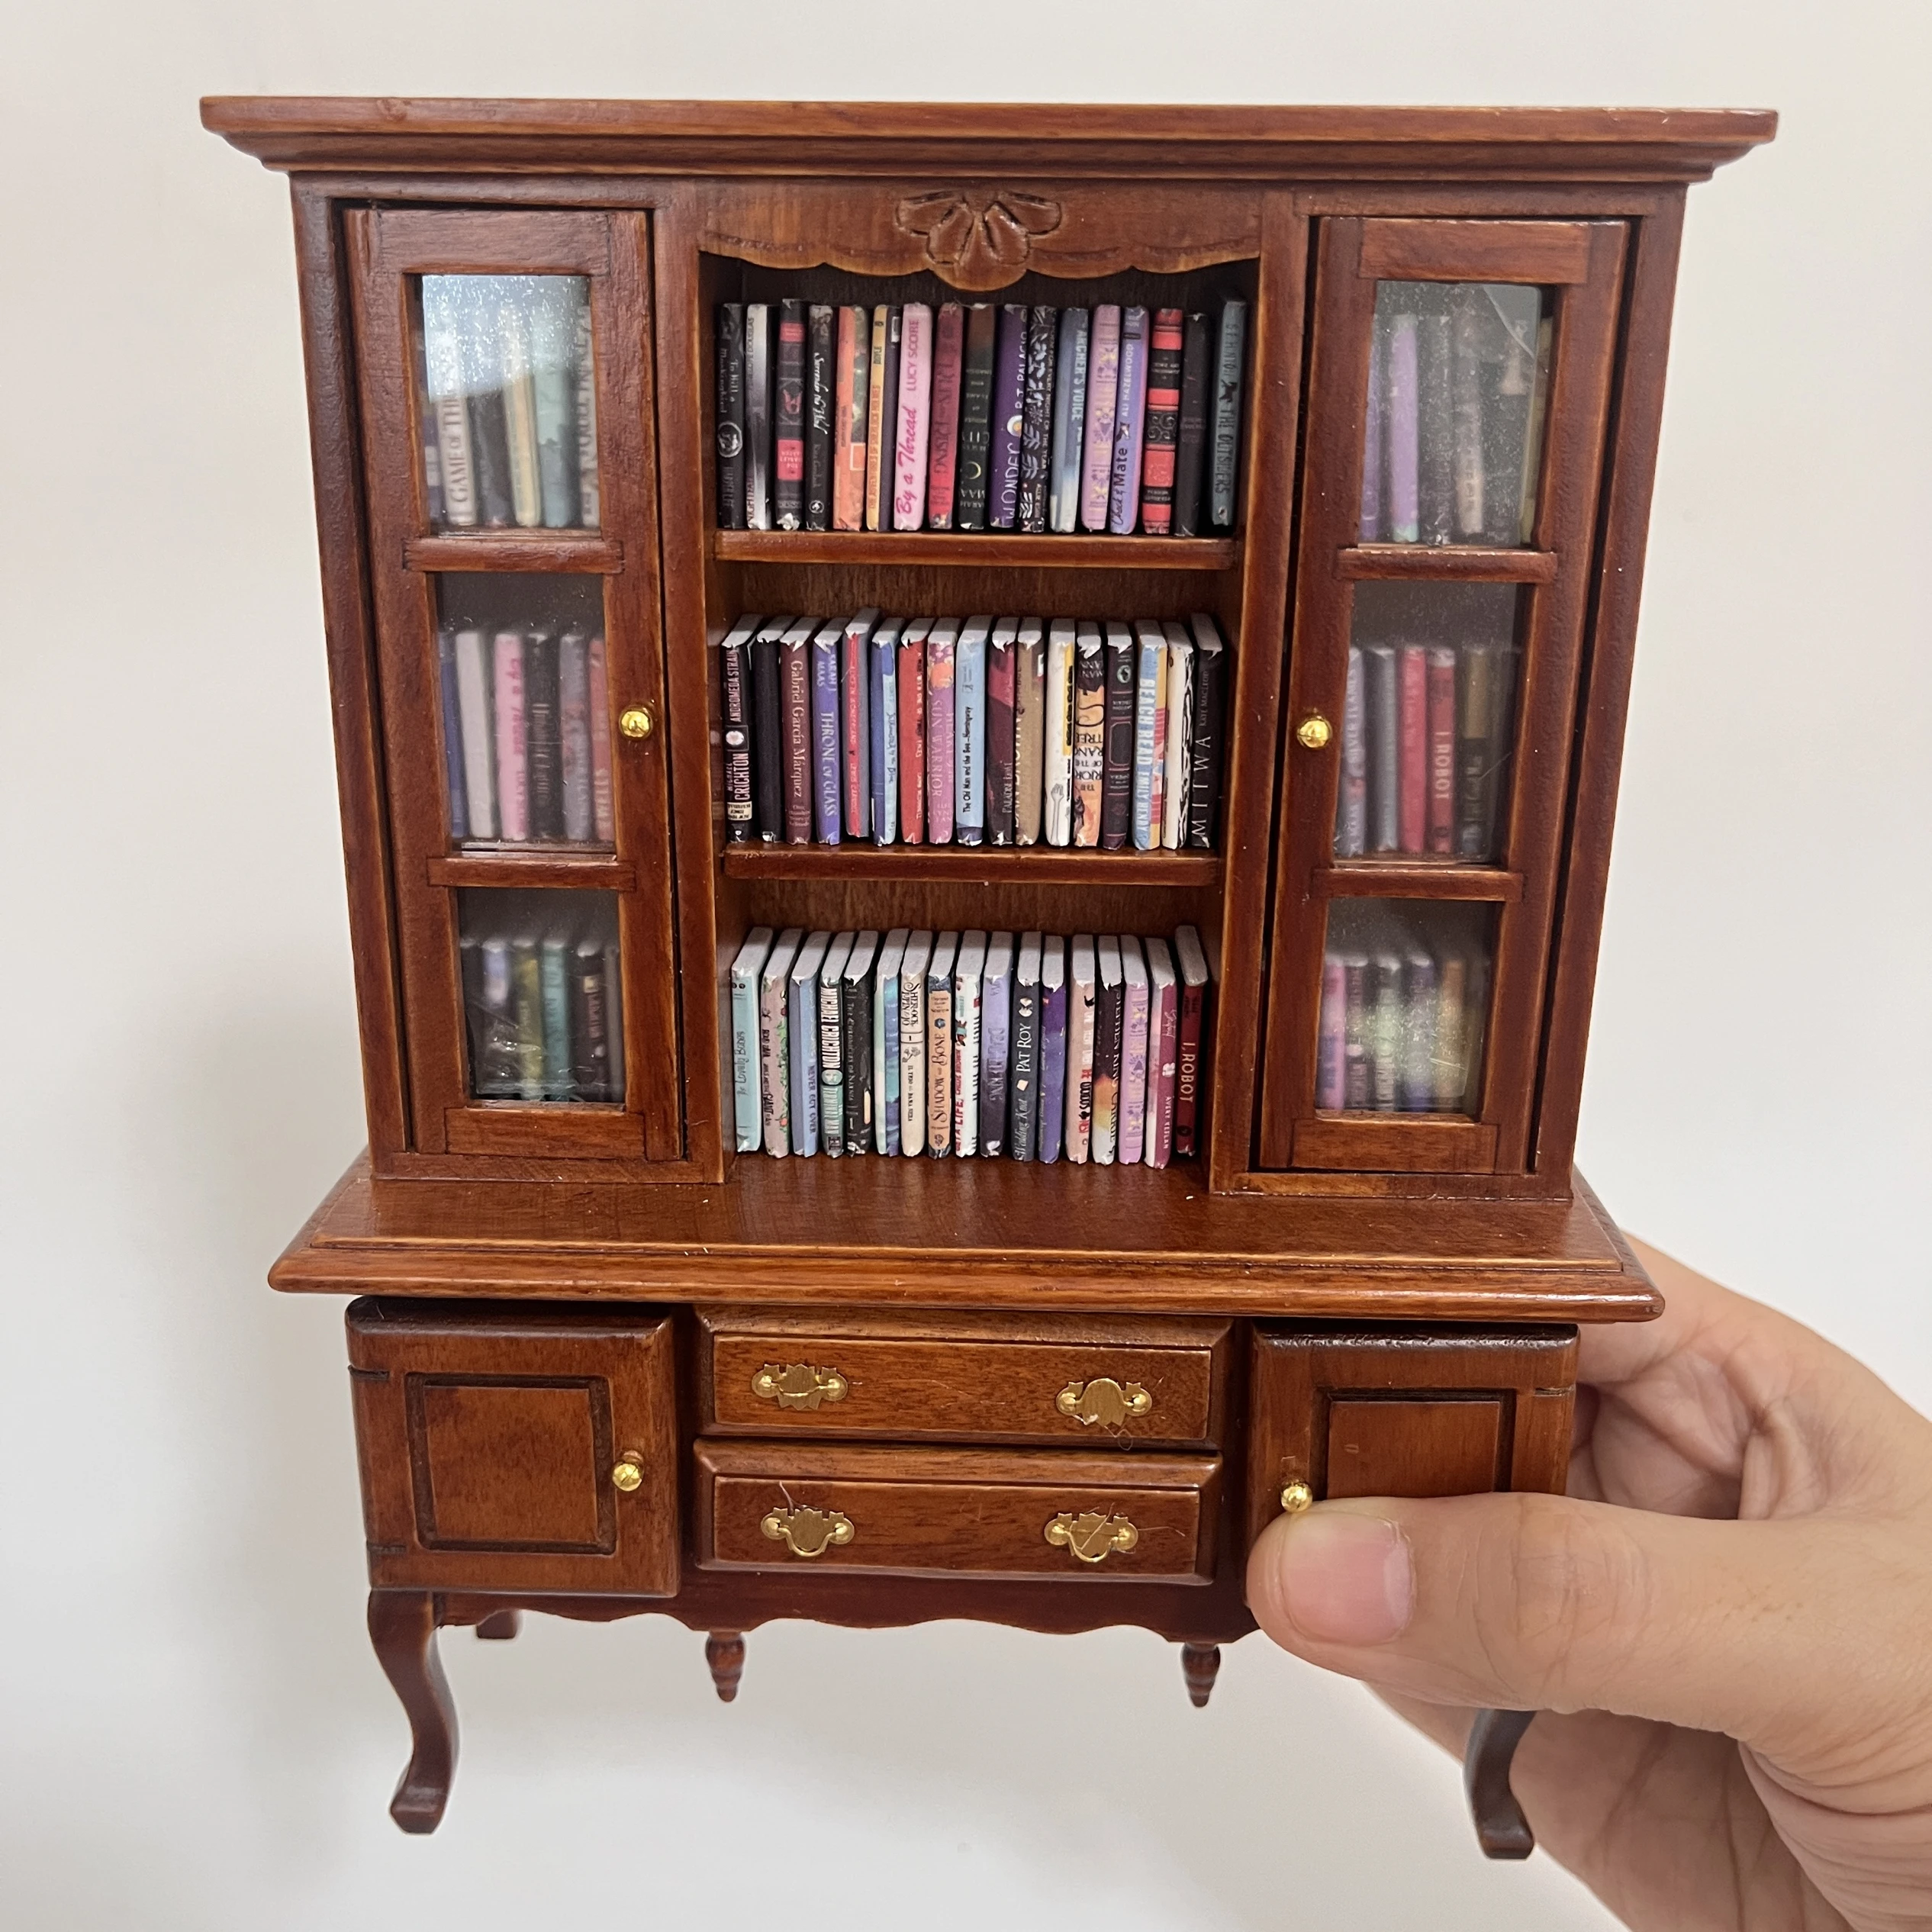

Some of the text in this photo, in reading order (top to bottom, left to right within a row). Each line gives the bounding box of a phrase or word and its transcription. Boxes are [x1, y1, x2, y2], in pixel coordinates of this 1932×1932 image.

[720, 348, 728, 414] Mockingbird
[730, 359, 739, 371] To
[813, 353, 829, 392] Surrender
[1074, 330, 1087, 385] ARCHER'S
[1122, 343, 1134, 401] HAZELWOOD
[729, 374, 739, 393] Kill
[1071, 388, 1085, 421] VOICE
[896, 320, 919, 514] By a Thread LUCY SCORE
[1044, 420, 1049, 430] OF
[1001, 443, 1019, 519] WONDER
[1113, 448, 1128, 486] Mate
[1215, 434, 1234, 494] OUTSIDERS
[1112, 497, 1124, 526] Check
[817, 661, 826, 687] MAAS
[729, 678, 742, 722] ANDROMEDA
[791, 660, 807, 798] Gabriel García Márquez
[819, 711, 835, 762] THRONE
[931, 700, 942, 797] SUN WARRIOR
[945, 712, 954, 755] HEART
[733, 753, 750, 800] CRICHTON
[1137, 678, 1155, 831] BEACH READ EMILY HENRY
[1435, 744, 1451, 800] ROBOT
[823, 781, 838, 816] GLASS
[821, 987, 840, 1068] MICHAEL CRICHTON
[906, 982, 921, 1027] SHERLOCK
[736, 1031, 745, 1055] Bones
[1016, 1023, 1032, 1072] PAT ROY
[735, 1058, 749, 1084] Lovely
[931, 1034, 947, 1122] SHADOW BONE
[1179, 1042, 1196, 1103] I, ROBOT
[823, 1087, 839, 1135] TERMINAL MAN
[955, 1098, 964, 1125] LIFE,
[1014, 1099, 1029, 1157] Wedding Knot
[1163, 1096, 1174, 1119] AVERY
